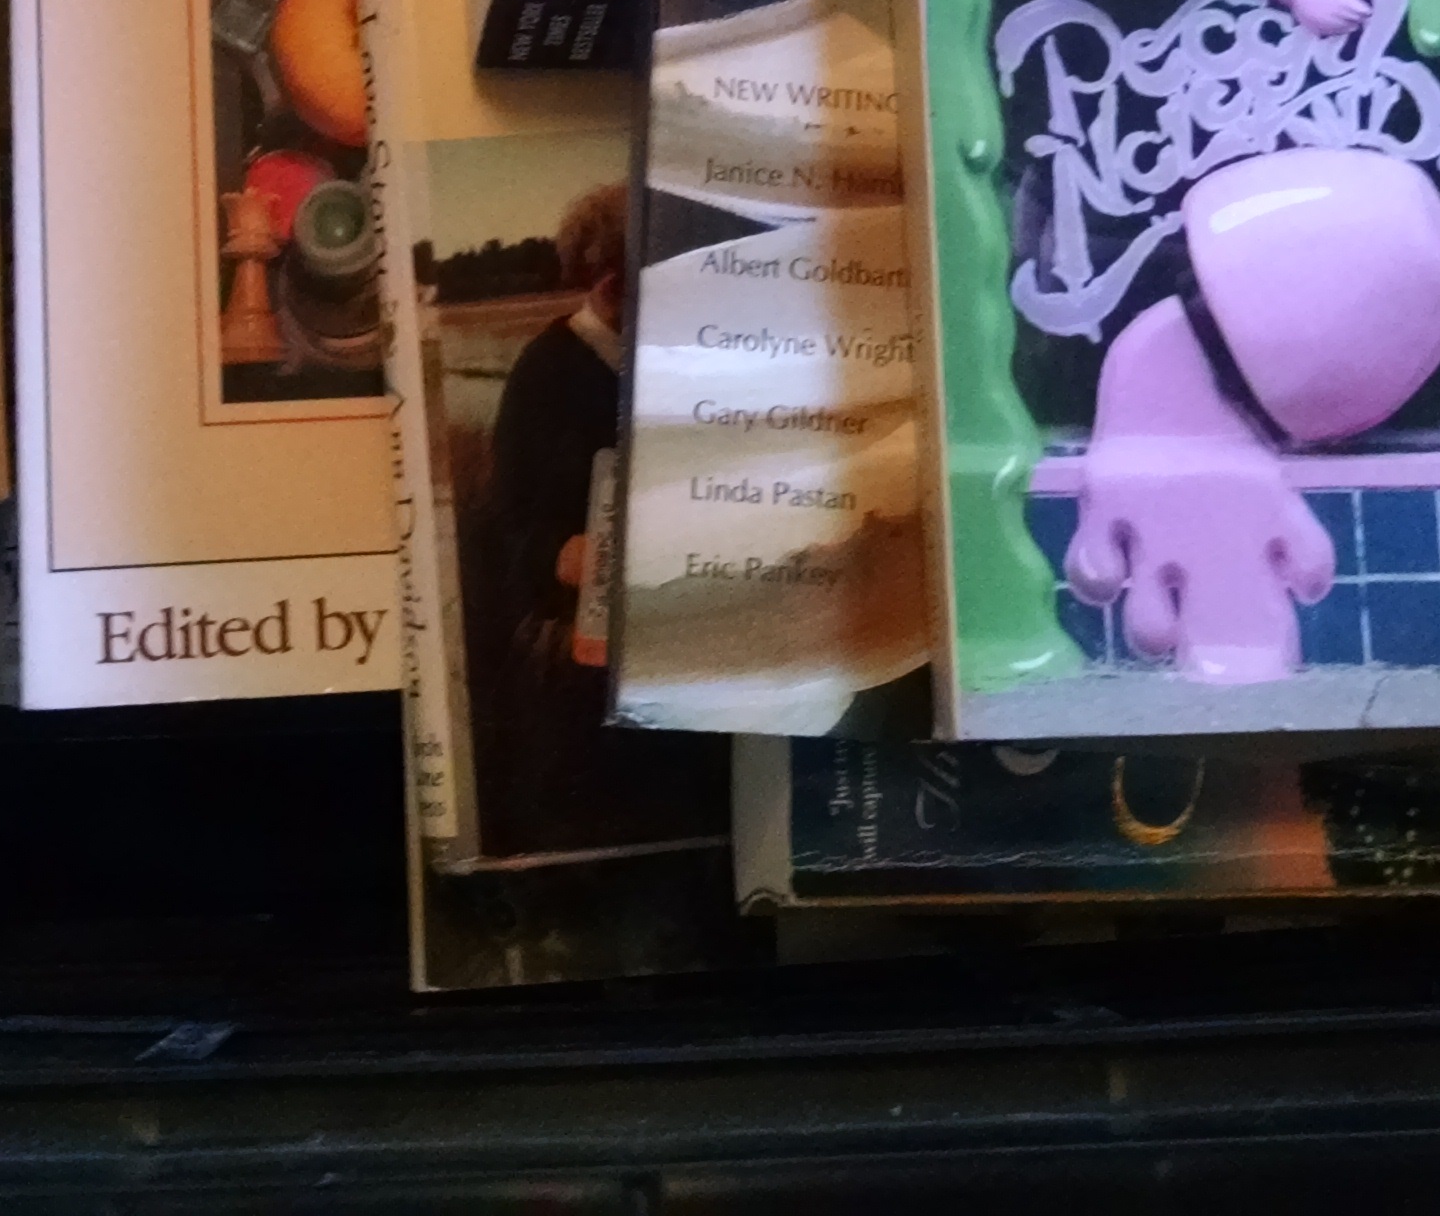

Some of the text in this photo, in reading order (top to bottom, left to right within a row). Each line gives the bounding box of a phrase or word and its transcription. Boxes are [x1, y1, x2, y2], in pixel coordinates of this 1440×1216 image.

[713, 74, 779, 103] NEW
[704, 156, 784, 187] Janice
[791, 163, 823, 191] N.
[699, 250, 781, 280] Albert
[696, 323, 918, 366] Carolyne Wright
[692, 398, 869, 435] Gary Gildner
[690, 474, 857, 512] Linda Pastan
[683, 550, 738, 581] Eric
[95, 596, 390, 666] Edited by
